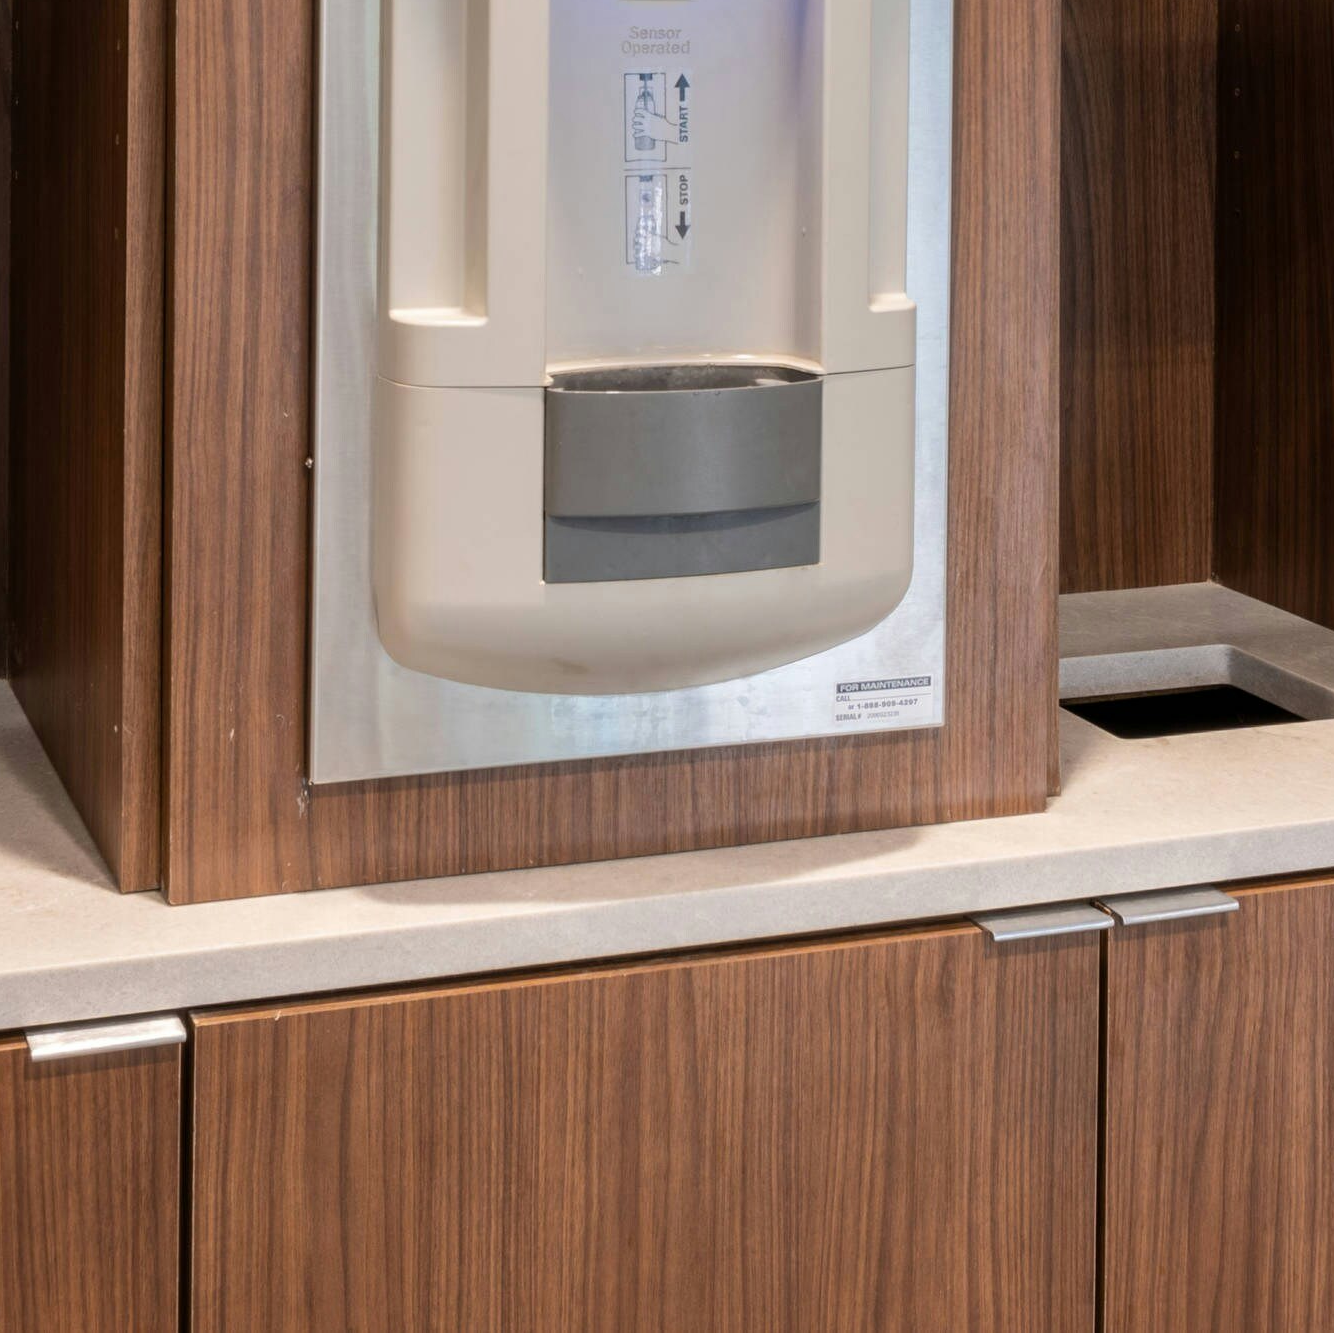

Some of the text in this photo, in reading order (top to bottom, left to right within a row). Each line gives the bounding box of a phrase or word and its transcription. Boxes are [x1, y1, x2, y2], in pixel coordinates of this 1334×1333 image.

[628, 25, 682, 40] Sensor
[620, 40, 691, 57] Operated
[679, 106, 689, 143] START
[679, 174, 689, 205] STOP
[839, 677, 930, 692] FOR MAINTENANCE
